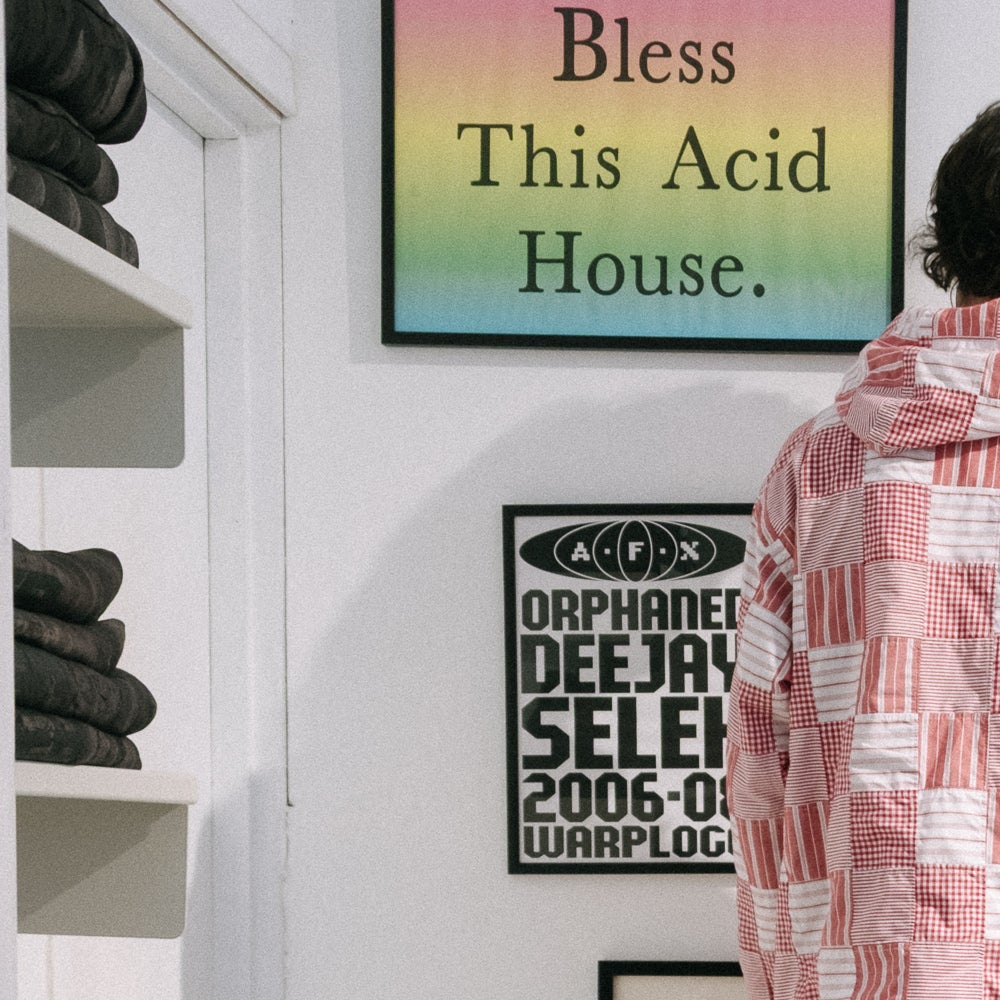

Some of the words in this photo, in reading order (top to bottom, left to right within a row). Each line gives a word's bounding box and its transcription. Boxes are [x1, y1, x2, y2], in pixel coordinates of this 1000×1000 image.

[553, 7, 735, 84] Bless
[457, 123, 621, 190] This
[661, 125, 831, 193] Acid
[518, 230, 766, 298] House.
[523, 825, 734, 859] WARPLOG
